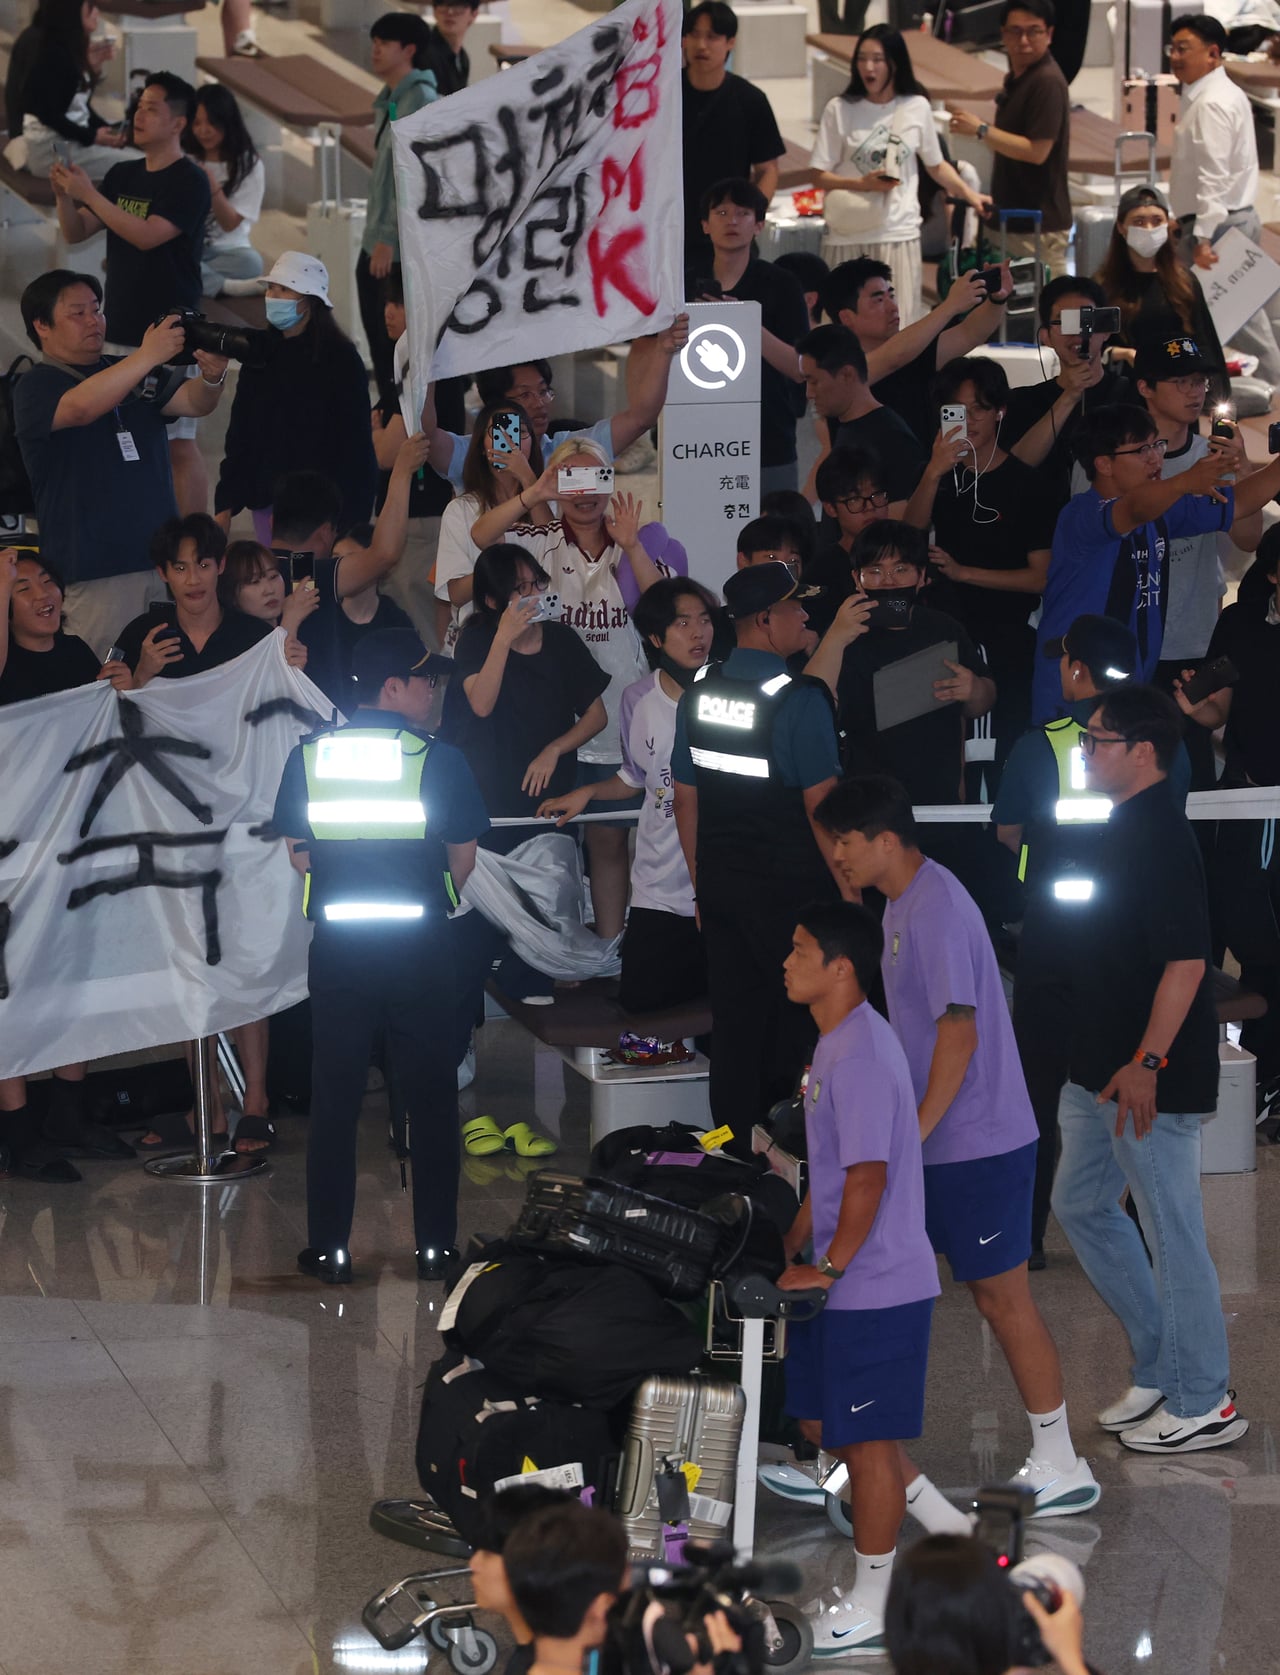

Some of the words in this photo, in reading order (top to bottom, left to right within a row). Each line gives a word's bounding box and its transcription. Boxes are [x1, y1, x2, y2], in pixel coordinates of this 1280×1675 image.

[672, 441, 751, 460] CHARGE
[719, 475, 750, 490] 充電
[723, 503, 750, 519] 충전
[560, 599, 628, 629] adidas
[585, 632, 610, 642] seoul
[698, 695, 755, 722] POLICE
